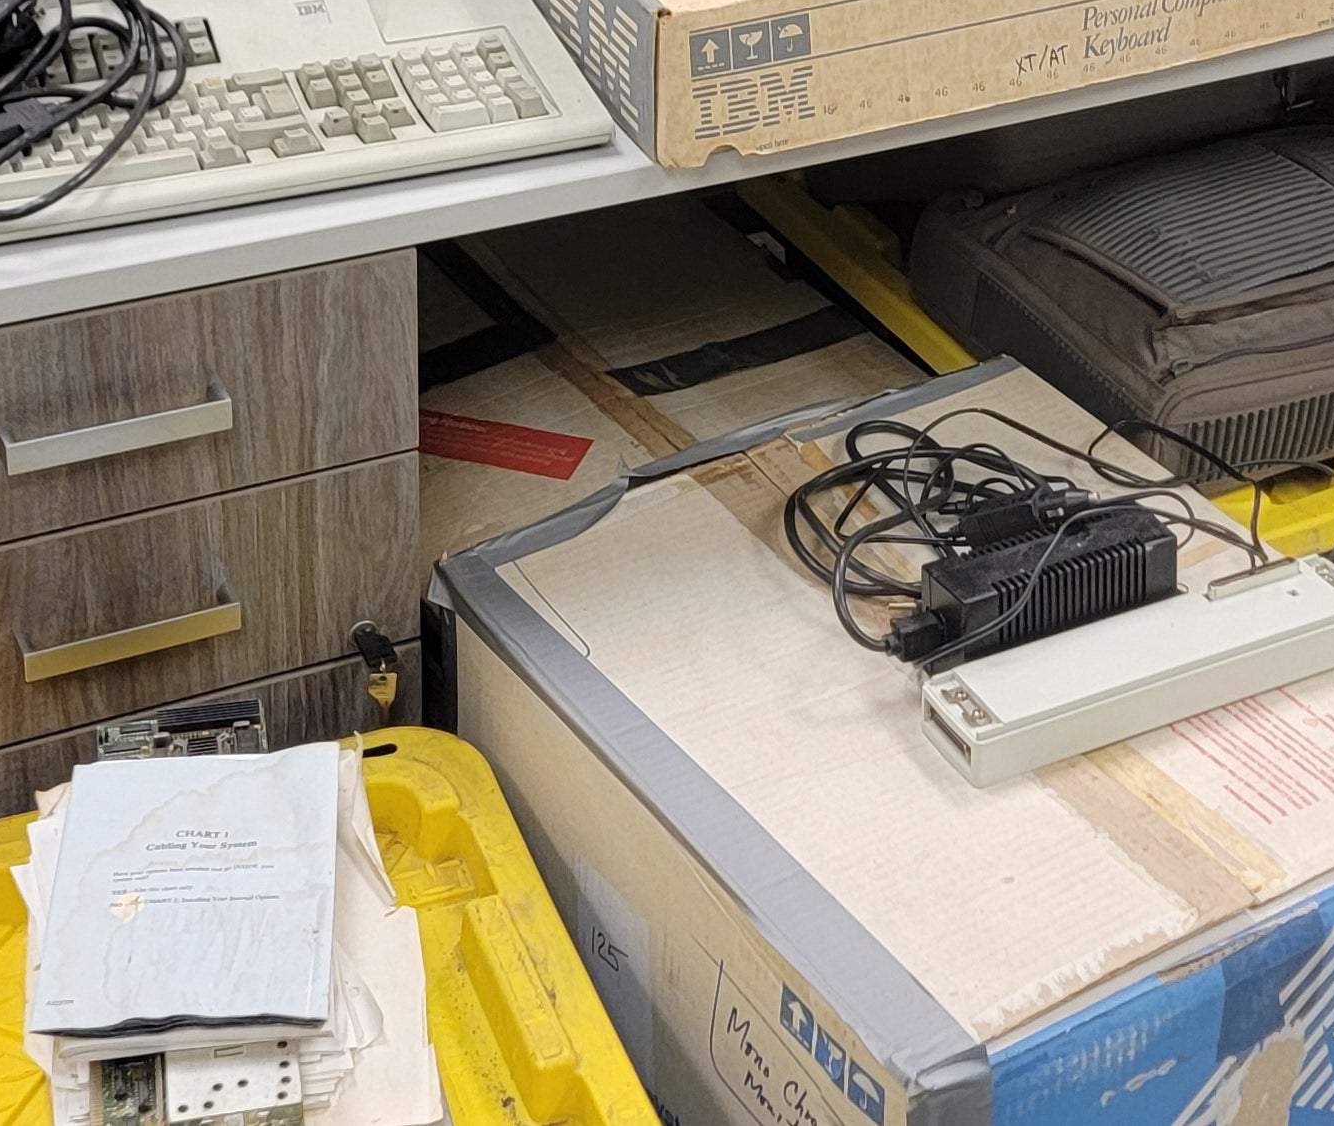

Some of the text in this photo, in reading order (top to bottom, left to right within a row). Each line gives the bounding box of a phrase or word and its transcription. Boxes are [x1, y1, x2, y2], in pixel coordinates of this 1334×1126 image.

[296, 3, 326, 16] IBM
[1014, 43, 1069, 76] XT/AT
[1082, 17, 1173, 66] Keyboard
[692, 65, 815, 140] IBM
[145, 839, 258, 852] Cabling Your System
[175, 829, 221, 839] CHART
[590, 925, 629, 972] 125
[726, 1005, 770, 1079] Mono
